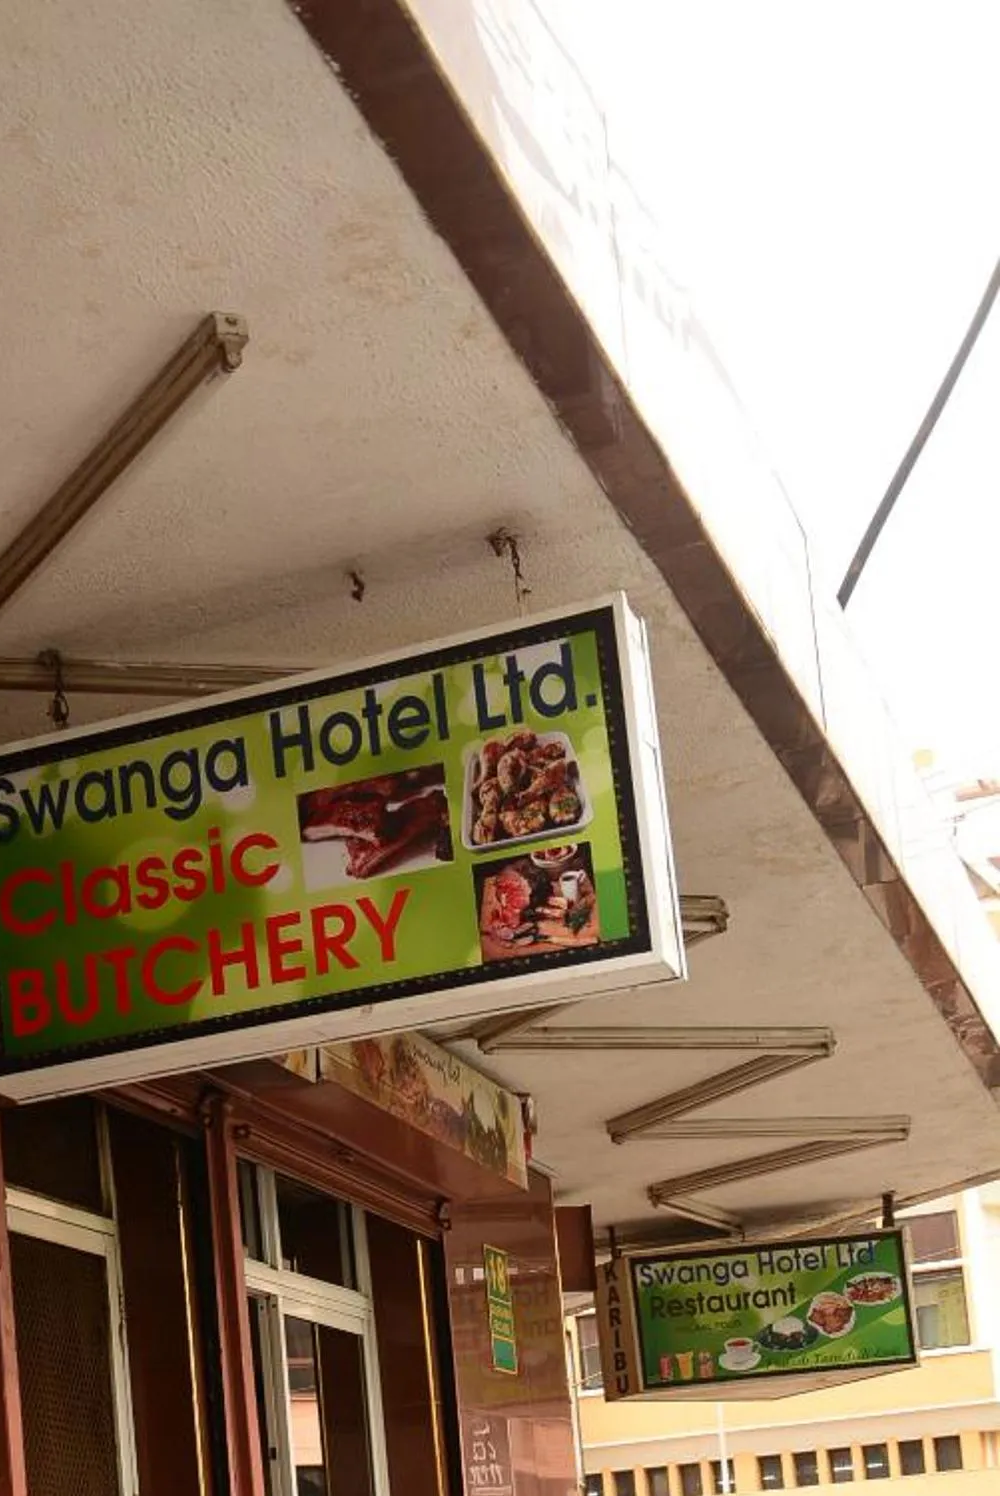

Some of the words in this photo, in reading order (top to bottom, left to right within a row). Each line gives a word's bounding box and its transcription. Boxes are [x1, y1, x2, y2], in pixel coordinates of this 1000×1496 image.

[270, 673, 449, 780] Hotel
[473, 644, 599, 733] Ltd.
[0, 826, 280, 937] Classic
[8, 888, 411, 1037] BUTCHERY
[639, 1259, 750, 1290] Swanga
[757, 1244, 829, 1277] Hotel
[836, 1241, 876, 1270] Ltd
[650, 1281, 797, 1321] Restaurant
[602, 1261, 630, 1394] KARIBU
